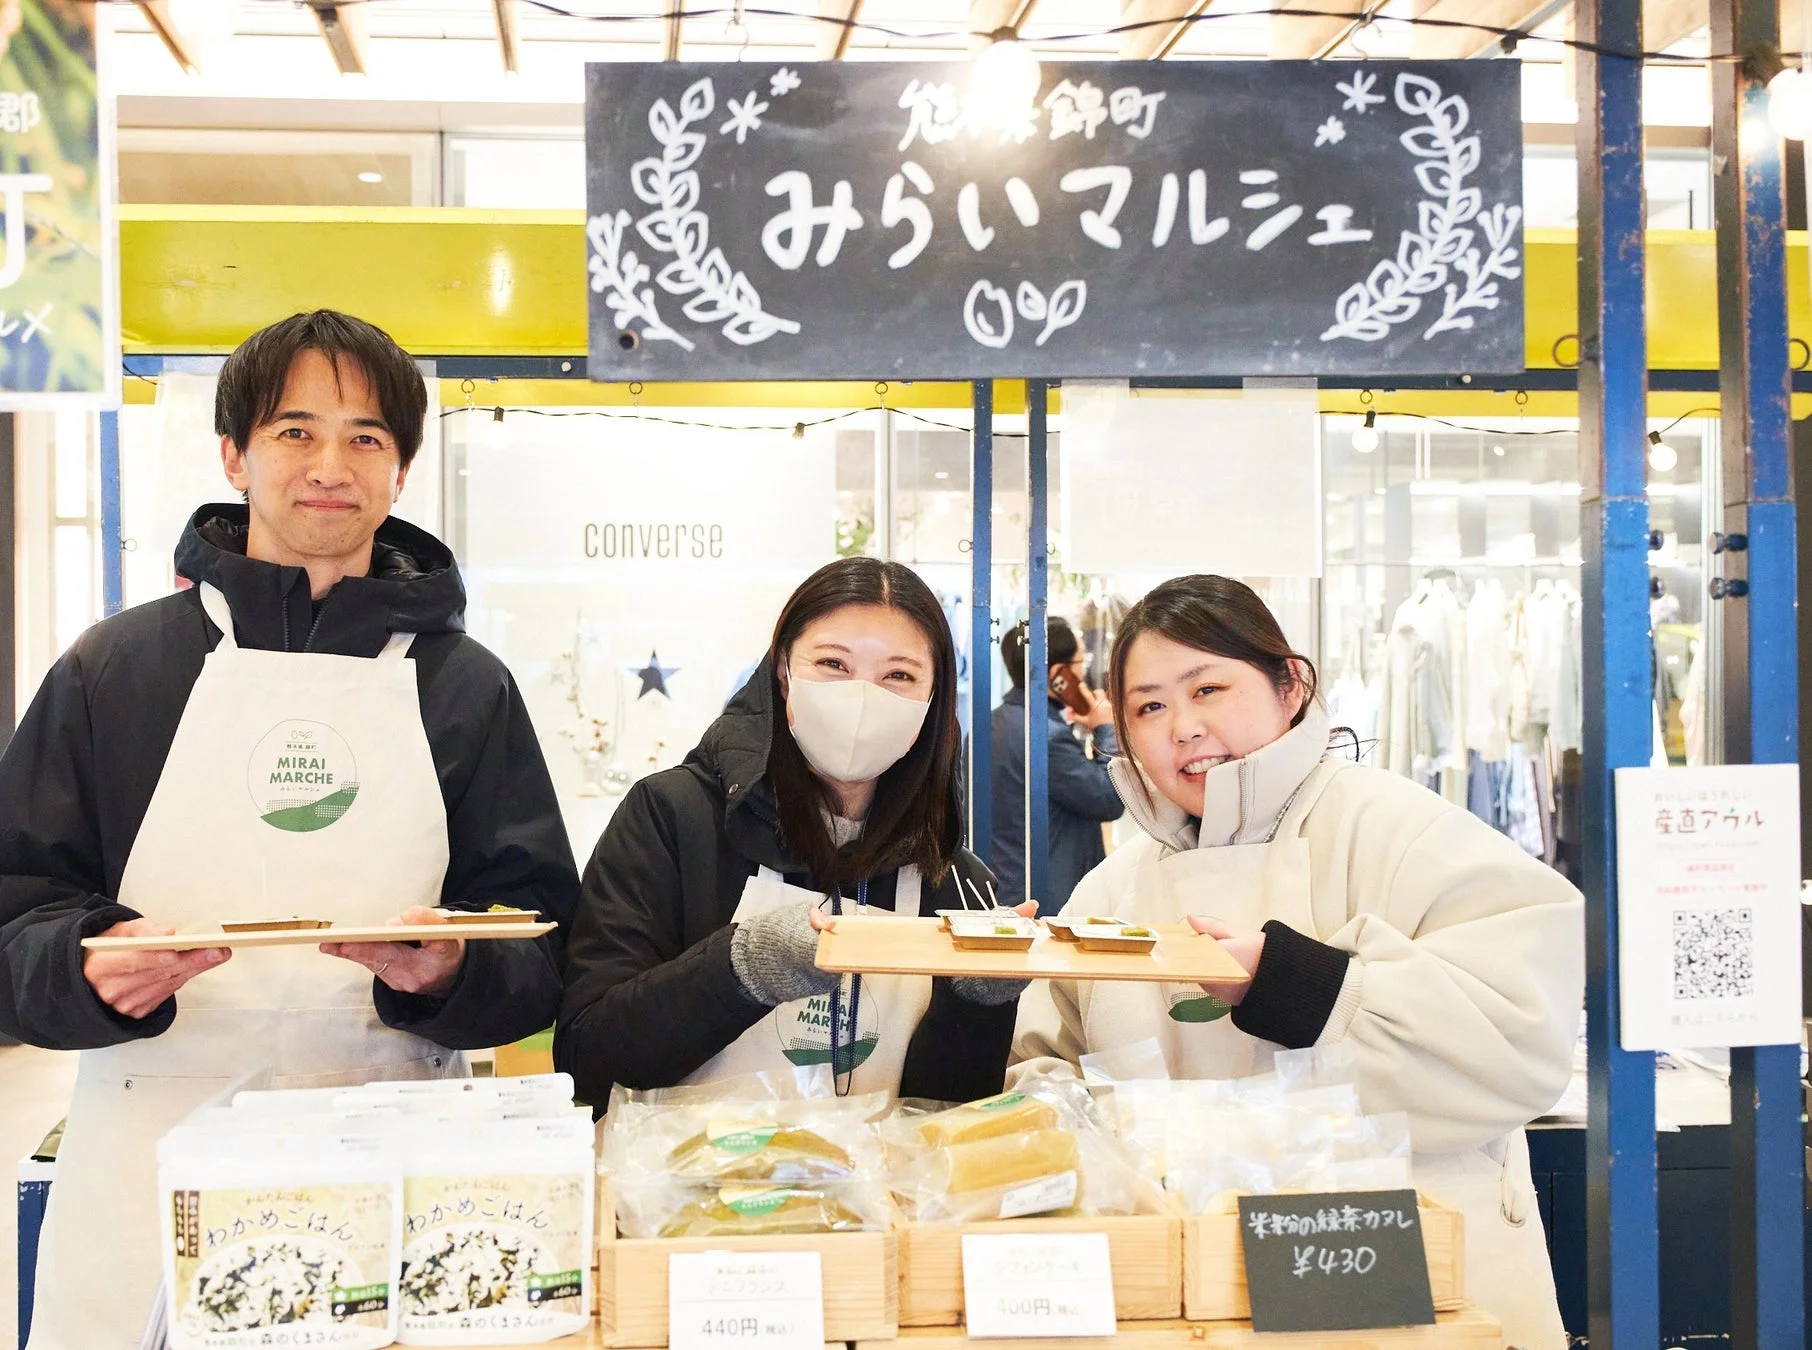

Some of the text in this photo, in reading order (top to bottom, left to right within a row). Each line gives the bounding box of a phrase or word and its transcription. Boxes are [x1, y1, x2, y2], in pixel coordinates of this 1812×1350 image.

[762, 160, 1374, 270] みらいマルシェ
[585, 523, 723, 559] converse
[277, 757, 326, 770] MIRAI
[269, 771, 334, 785] MARCHE
[1655, 808, 1765, 835] 産直アウル
[807, 998, 851, 1018] MIA
[797, 1010, 851, 1032] MARH
[405, 1195, 549, 1234] わかめごはん
[205, 1207, 355, 1248] わかめごはん
[1293, 1245, 1377, 1279] ¥430
[996, 1298, 1051, 1317] 400円
[702, 1317, 759, 1337] 440円
